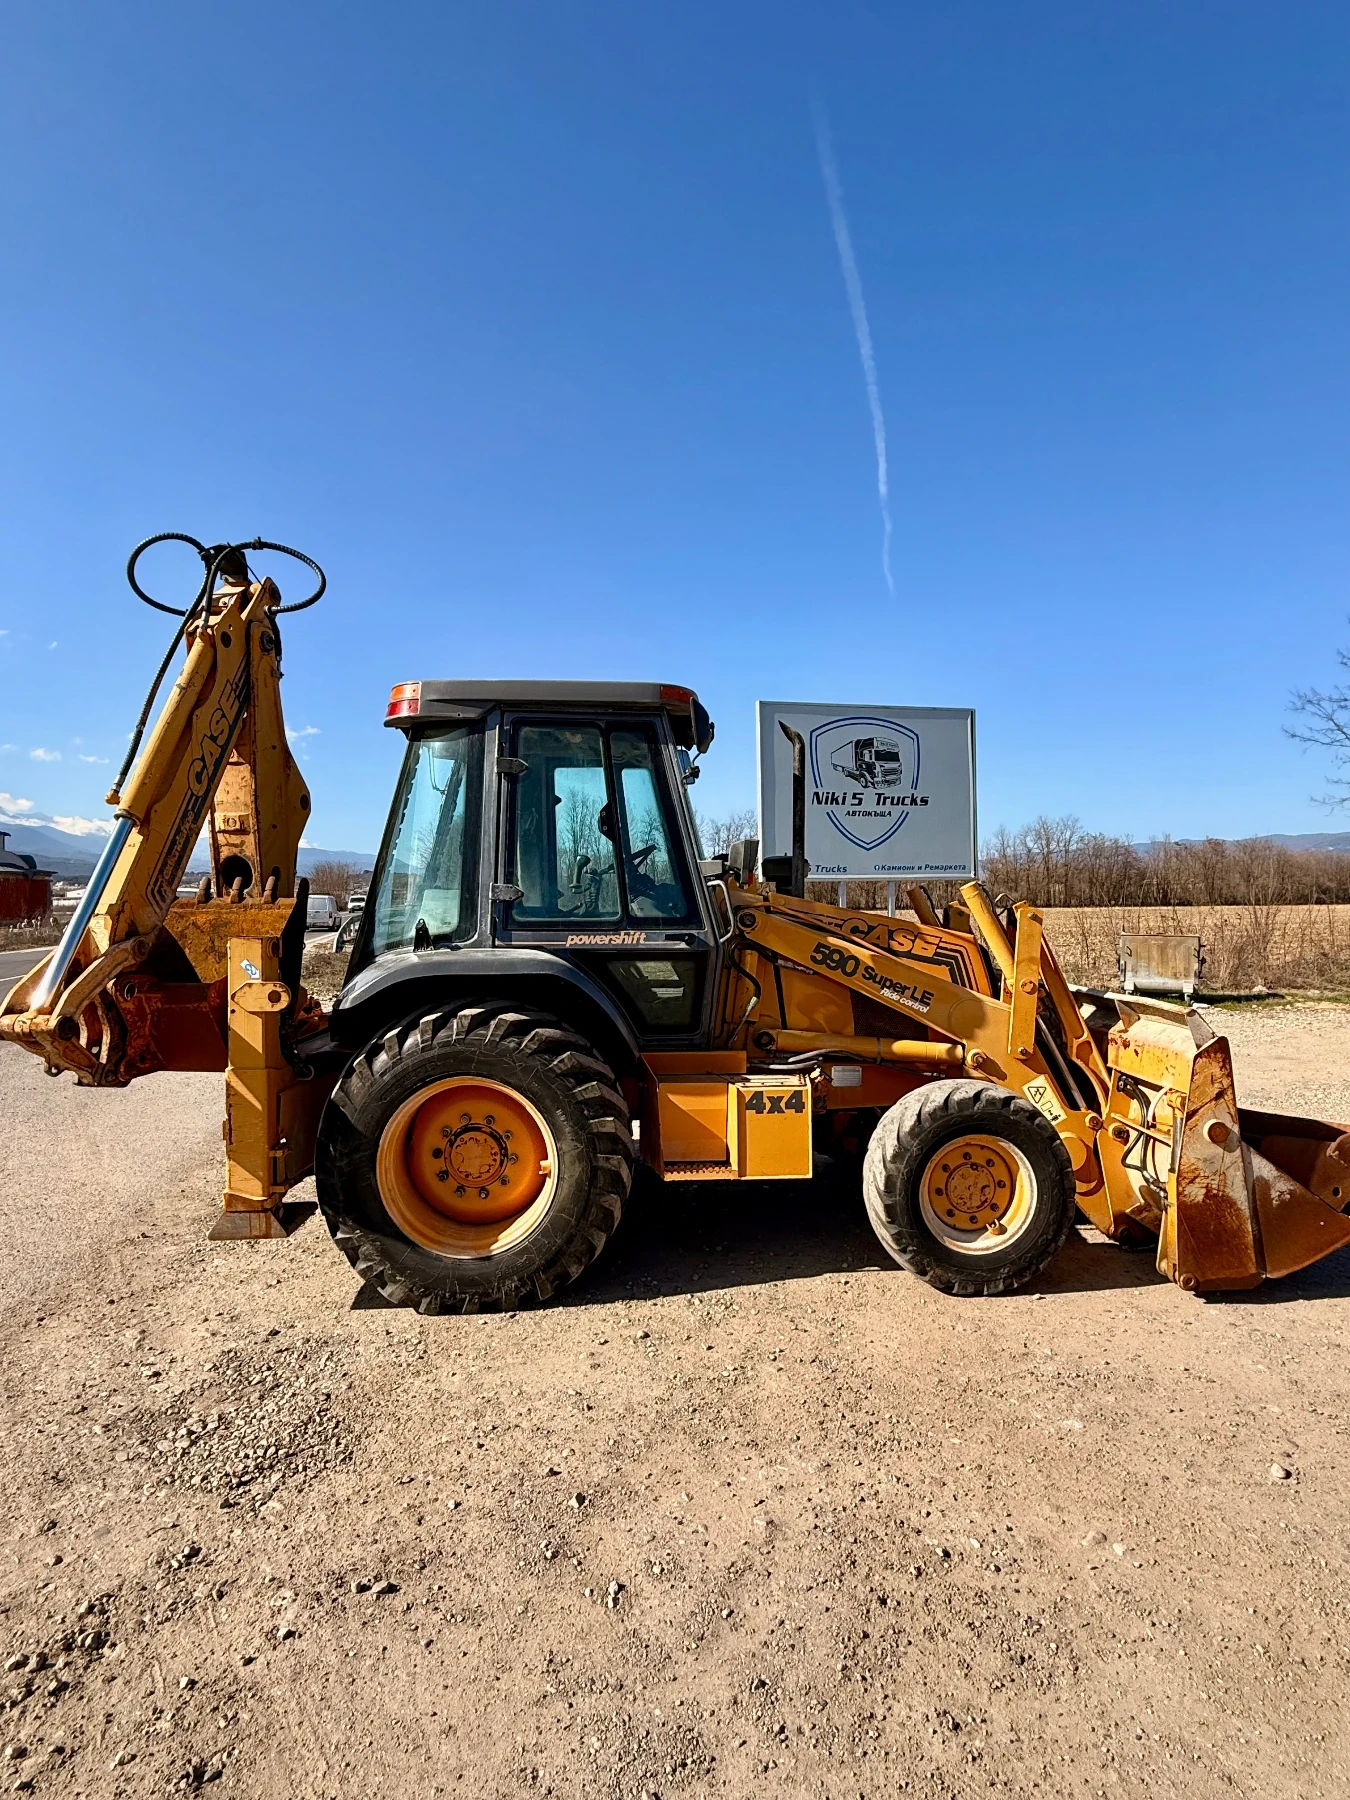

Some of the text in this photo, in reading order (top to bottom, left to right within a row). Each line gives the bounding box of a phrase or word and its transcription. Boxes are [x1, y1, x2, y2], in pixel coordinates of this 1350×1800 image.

[188, 679, 240, 797] CASE
[812, 791, 929, 806] Niki 5 Trucks
[815, 864, 848, 873] Trucks
[924, 863, 967, 872] Ремаркета
[566, 931, 646, 947] powershift
[841, 917, 943, 958] CASE
[809, 941, 861, 977] 590
[880, 987, 930, 1013] Ride control
[745, 1090, 805, 1114] 4x4
